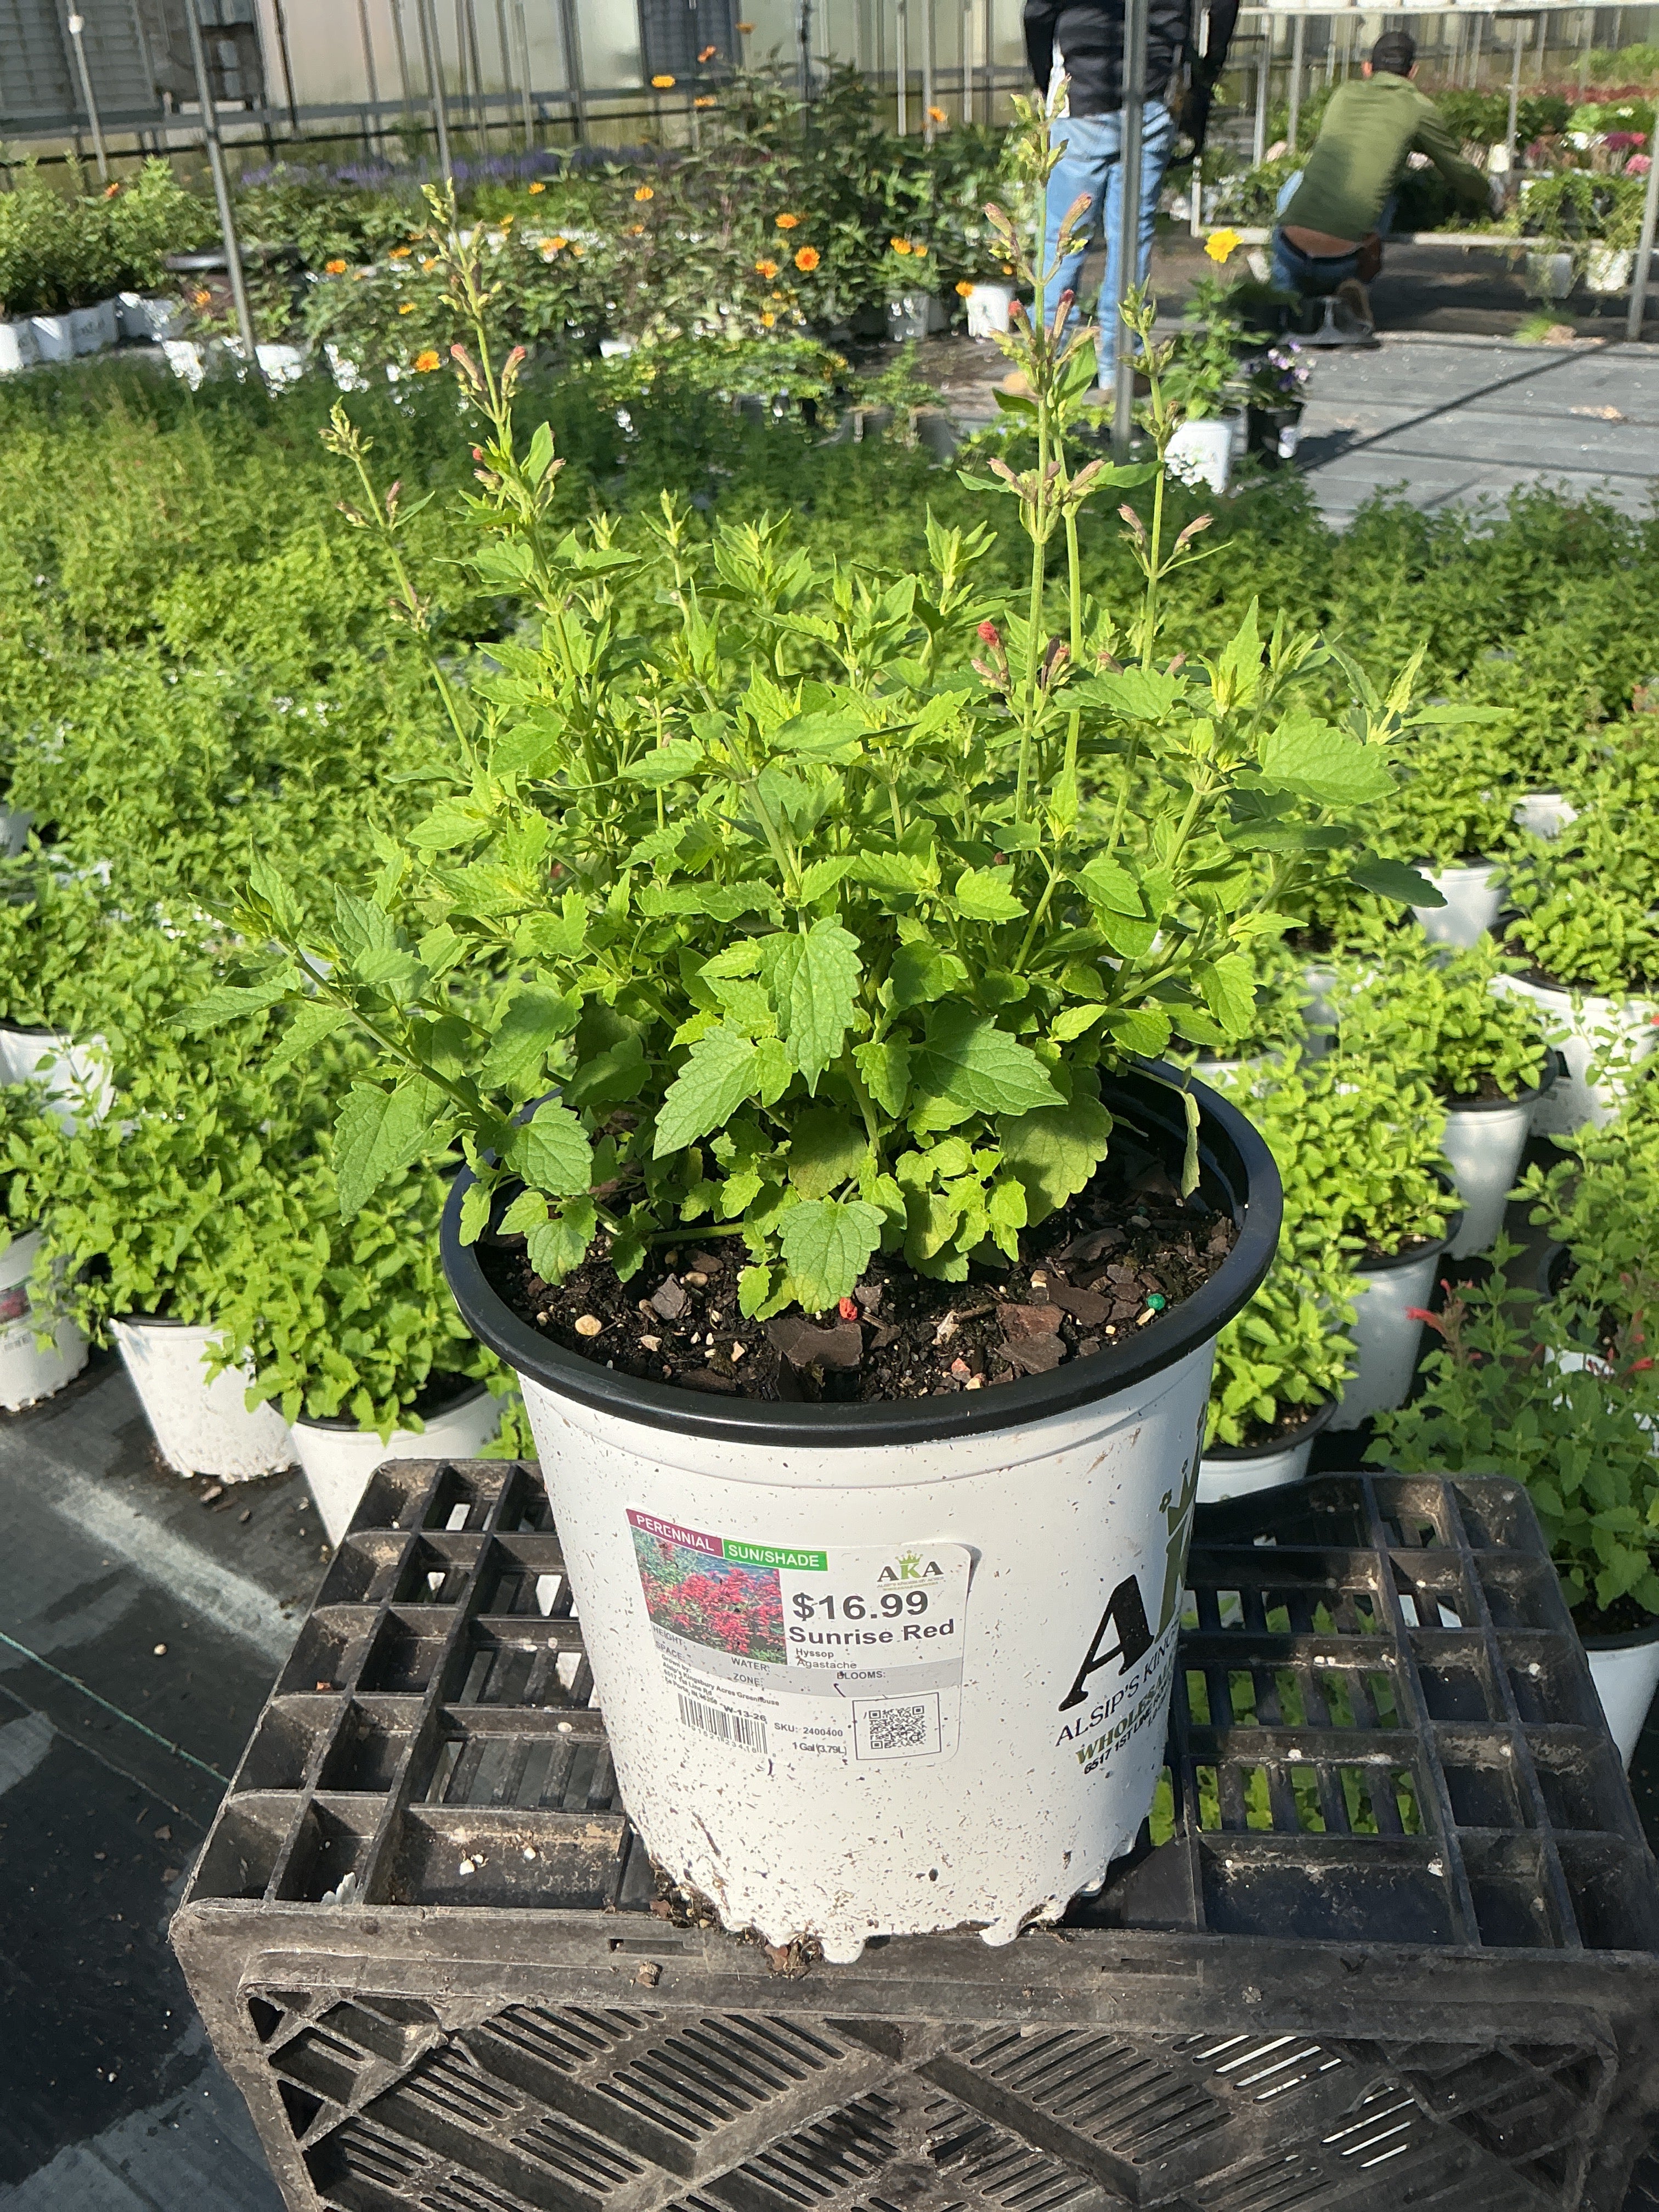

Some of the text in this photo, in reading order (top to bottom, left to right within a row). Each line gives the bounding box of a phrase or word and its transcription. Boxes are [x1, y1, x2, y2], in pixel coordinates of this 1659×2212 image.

[636, 1514, 715, 1551] PERENNIAL
[729, 1545, 820, 1567] SUN/SHADE
[877, 1560, 944, 1582] AKA
[792, 1590, 928, 1621] $16.99
[789, 1618, 954, 1645] Sunrise Red
[796, 1648, 834, 1659] Hyssop
[797, 1658, 857, 1669] Agastache
[837, 1671, 886, 1679] BLOOMS:
[1055, 1674, 1139, 1747] ALSIP'S
[774, 1722, 843, 1737] SKU: 2400400
[1084, 1747, 1112, 1774] 6517
